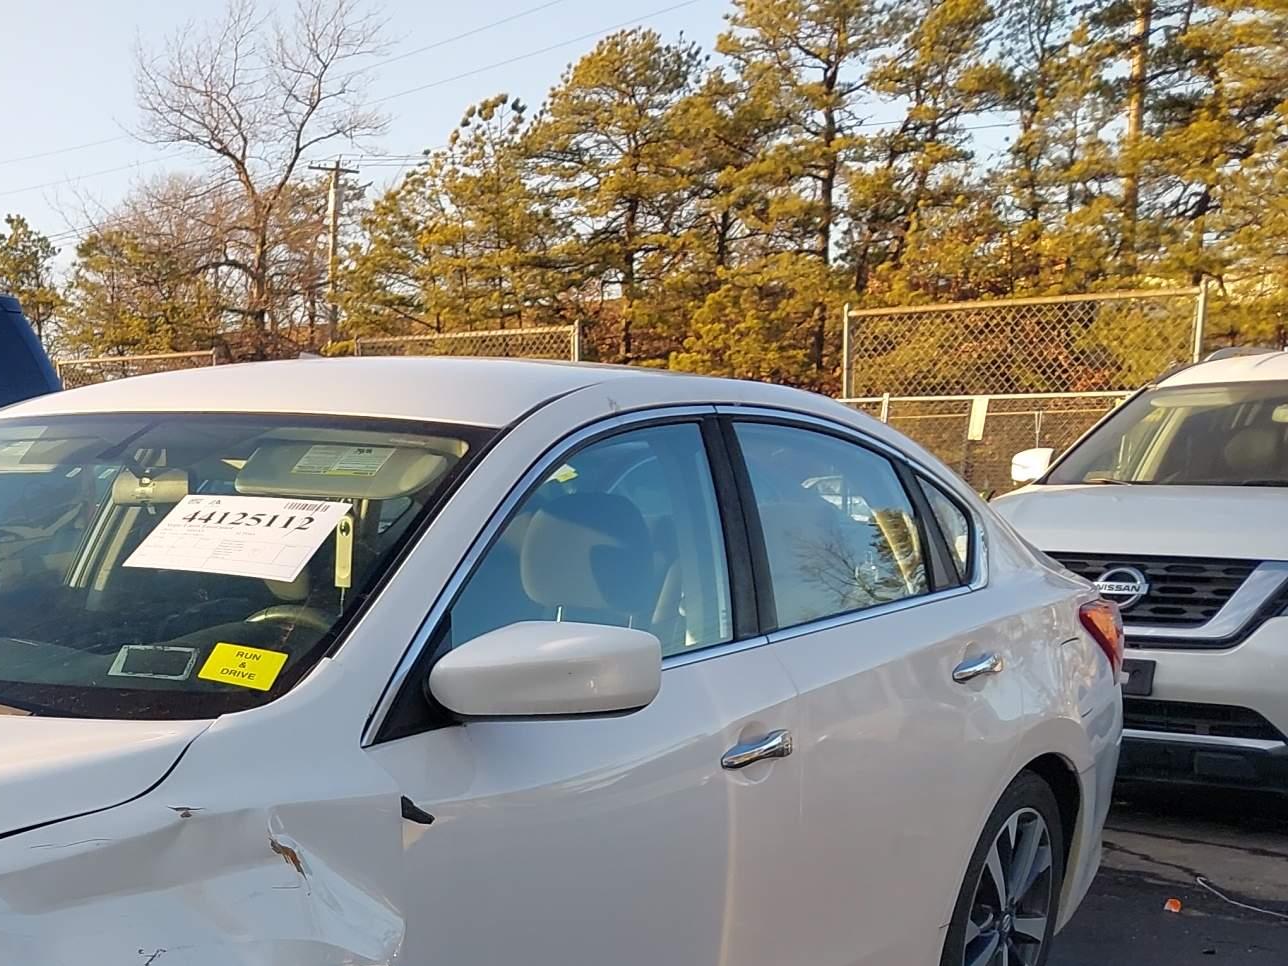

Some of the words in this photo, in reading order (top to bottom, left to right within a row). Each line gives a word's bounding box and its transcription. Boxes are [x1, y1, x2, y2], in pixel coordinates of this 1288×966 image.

[182, 510, 316, 531] 44125112
[1096, 583, 1141, 593] NISSAN
[235, 650, 262, 661] RUN
[238, 661, 247, 669] &
[220, 667, 257, 681] DRIVE
